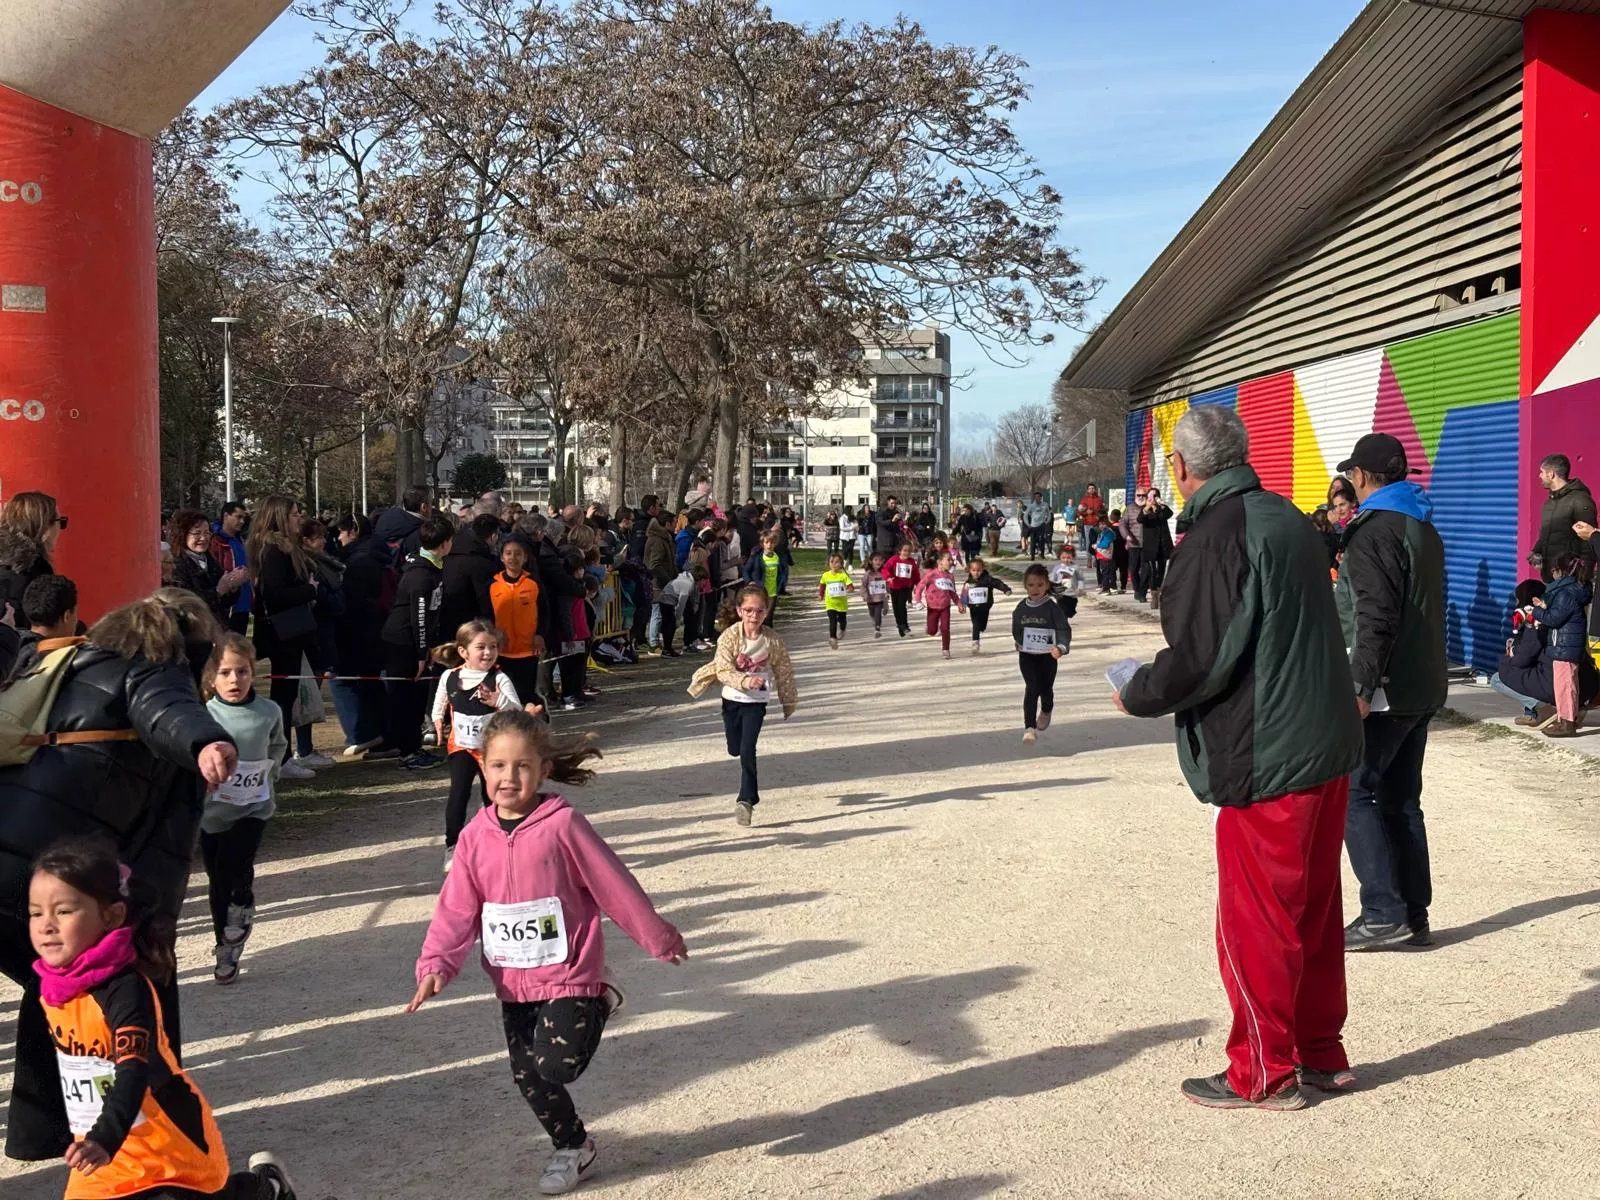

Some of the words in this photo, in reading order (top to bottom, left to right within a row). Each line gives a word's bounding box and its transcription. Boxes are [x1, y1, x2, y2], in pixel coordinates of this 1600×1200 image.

[418, 597, 426, 627] MISSION
[1031, 634, 1047, 643] 325
[232, 773, 260, 787] 265
[499, 919, 539, 941] 365
